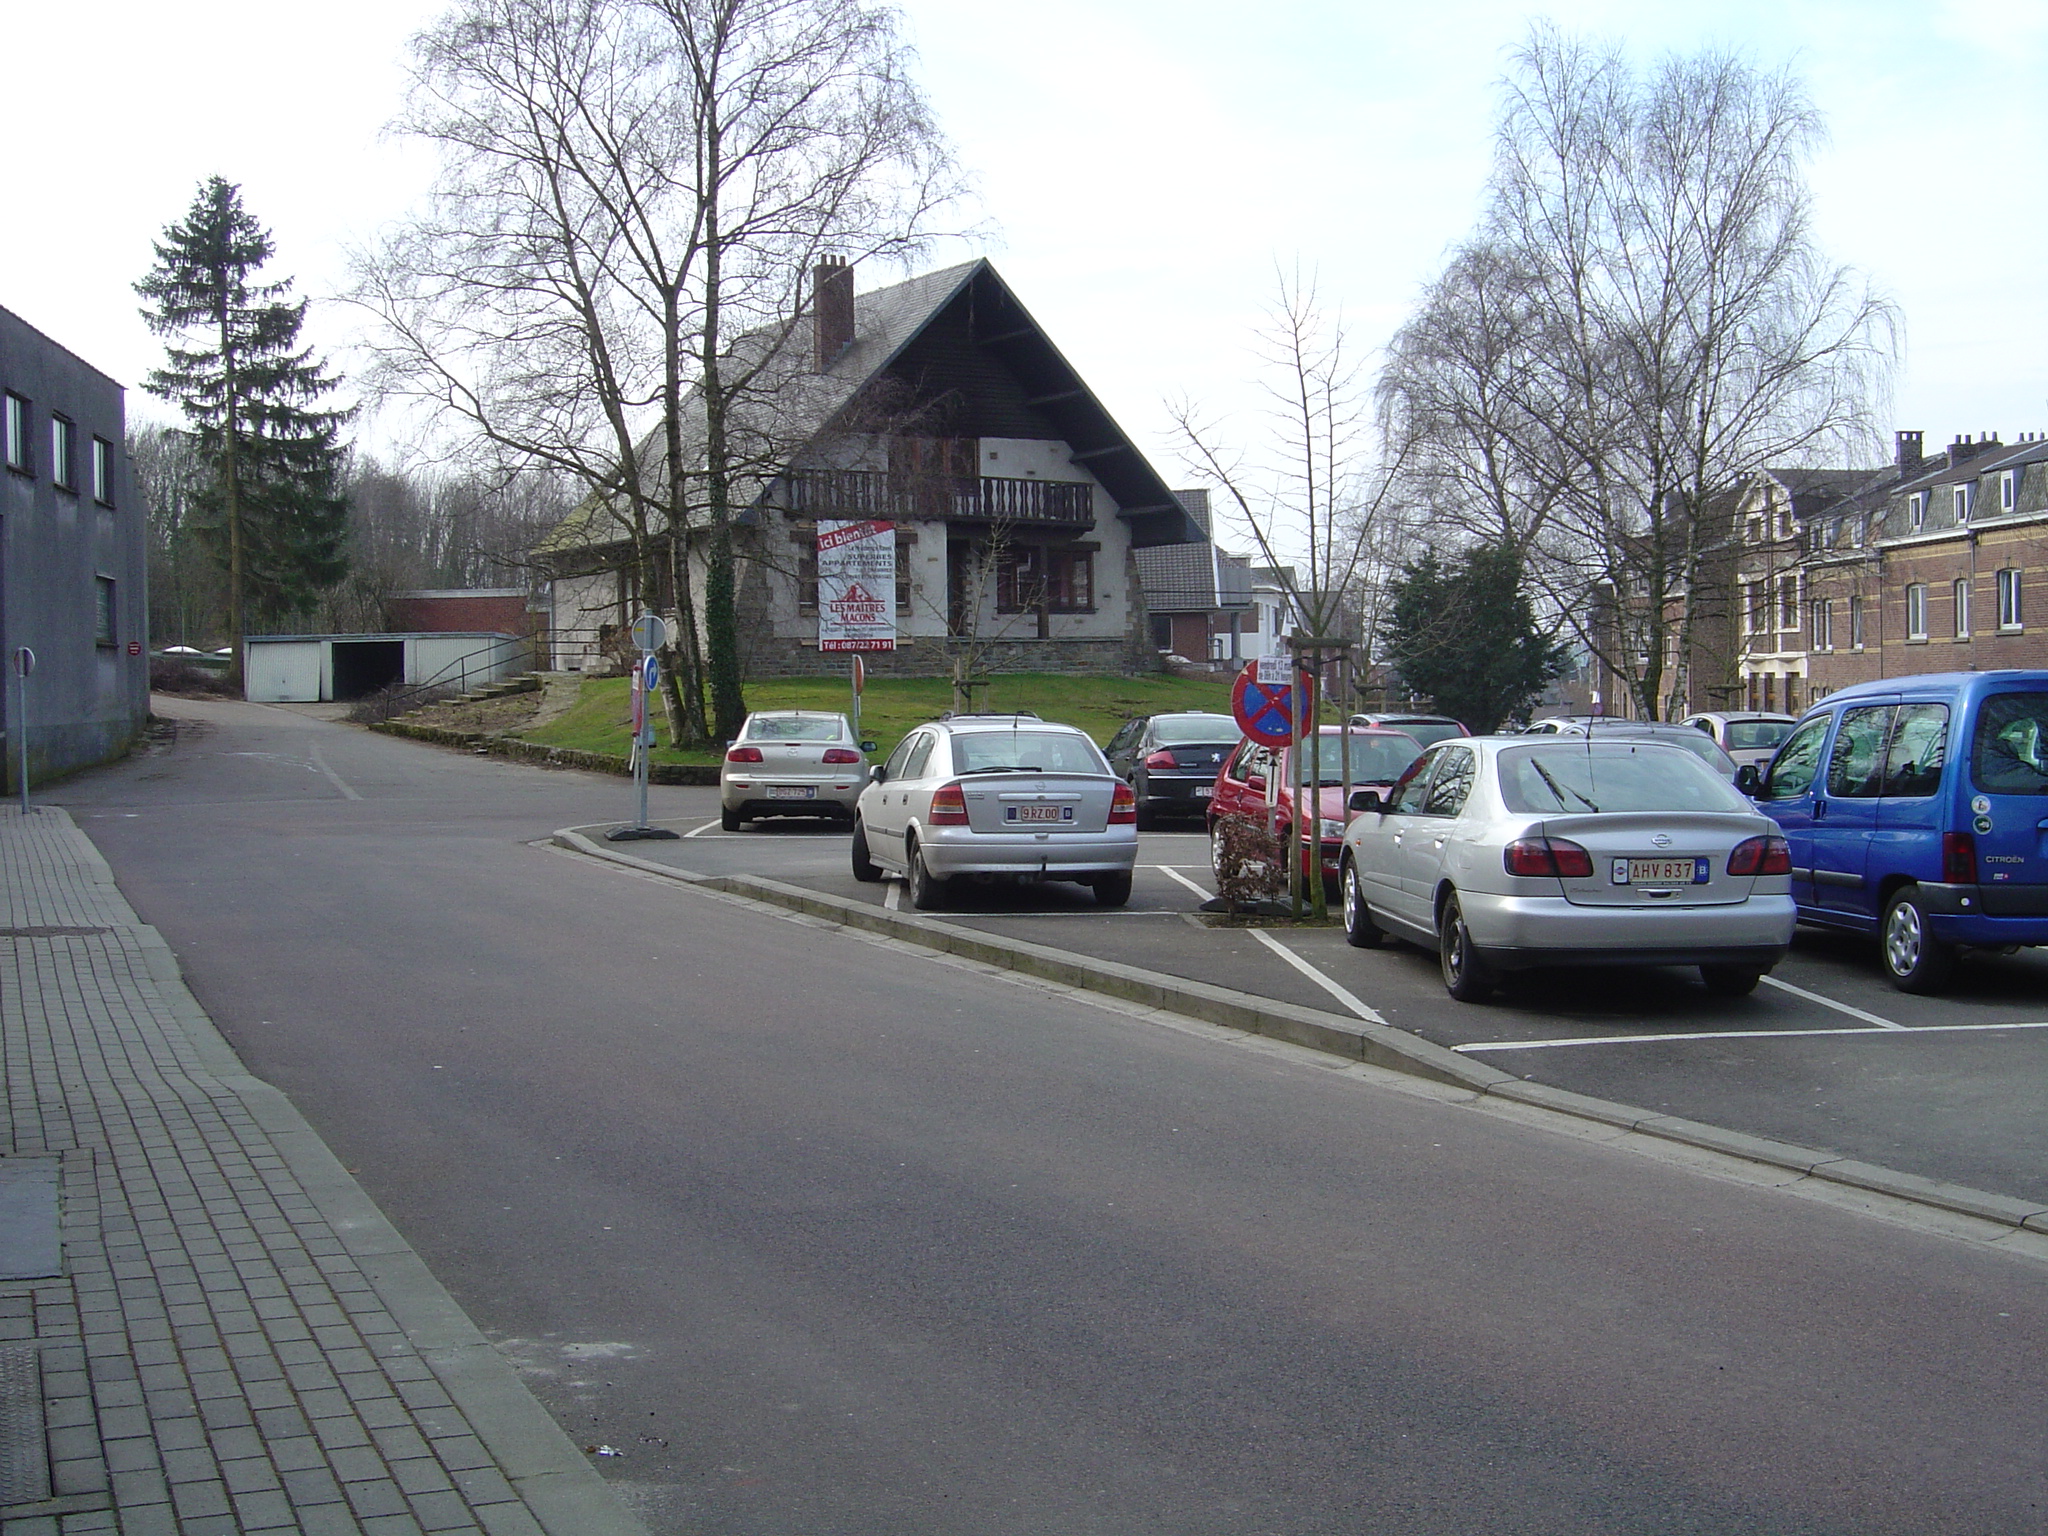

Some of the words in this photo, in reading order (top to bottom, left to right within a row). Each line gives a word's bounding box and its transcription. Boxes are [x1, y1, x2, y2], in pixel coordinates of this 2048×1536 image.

[819, 535, 834, 549] ici
[830, 603, 846, 612] LES
[1632, 863, 1660, 878] AHV
[1664, 863, 1692, 878] 837
